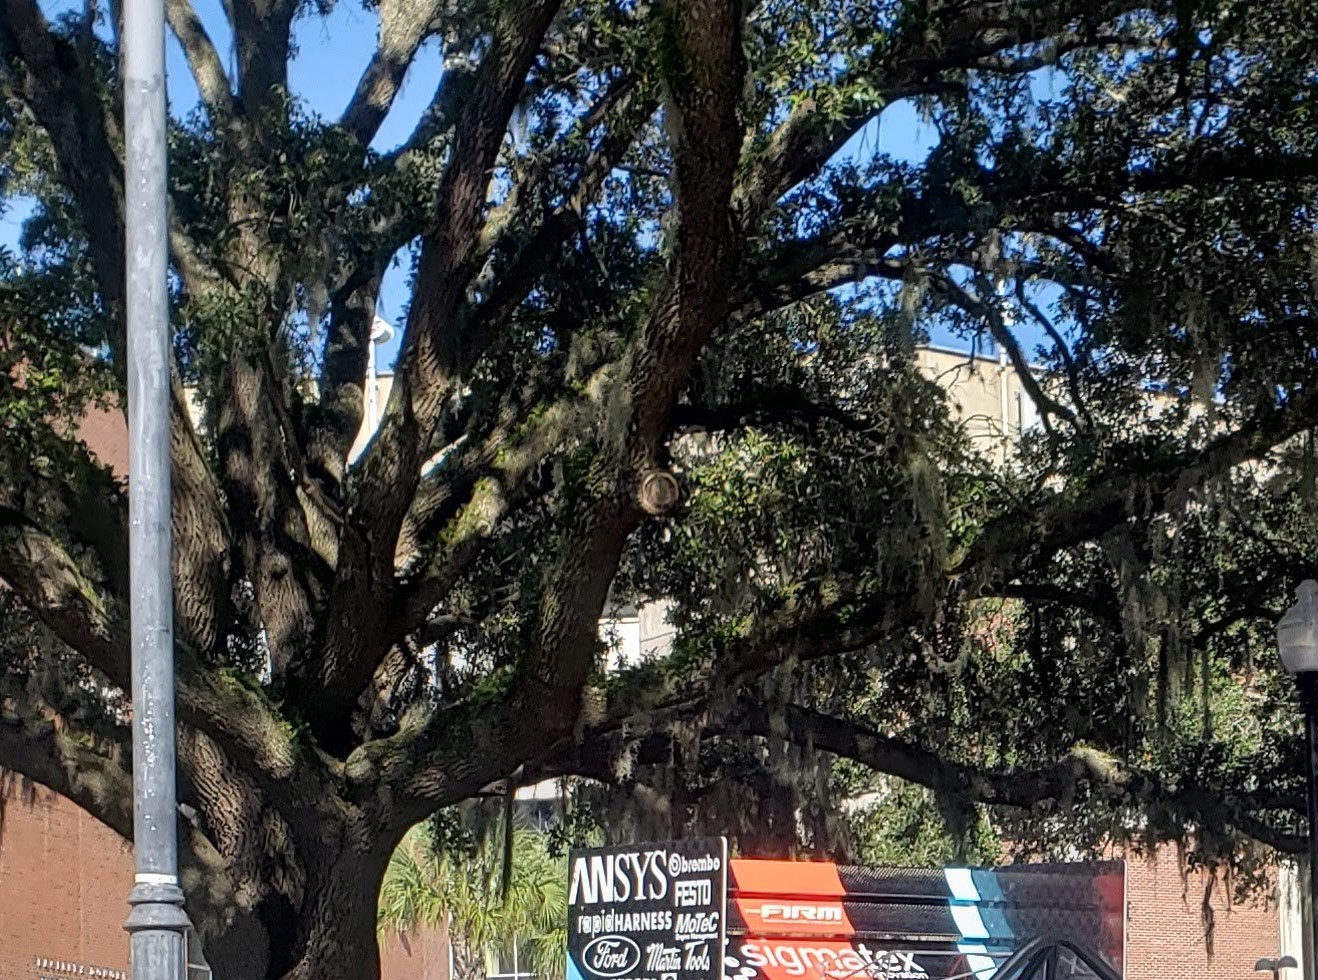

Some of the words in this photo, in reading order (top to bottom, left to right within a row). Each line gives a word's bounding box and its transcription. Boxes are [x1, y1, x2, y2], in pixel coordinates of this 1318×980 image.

[568, 849, 669, 906] ANSYS
[681, 853, 721, 874] brembo
[674, 879, 712, 907] FESTO
[577, 908, 673, 939] rapidHARNESS
[675, 911, 720, 935] MoTeC
[761, 904, 842, 921] FIRM
[592, 940, 629, 969] Ford
[646, 942, 682, 972] Martin
[684, 940, 711, 972] Tools
[740, 943, 926, 977] sigmatex
